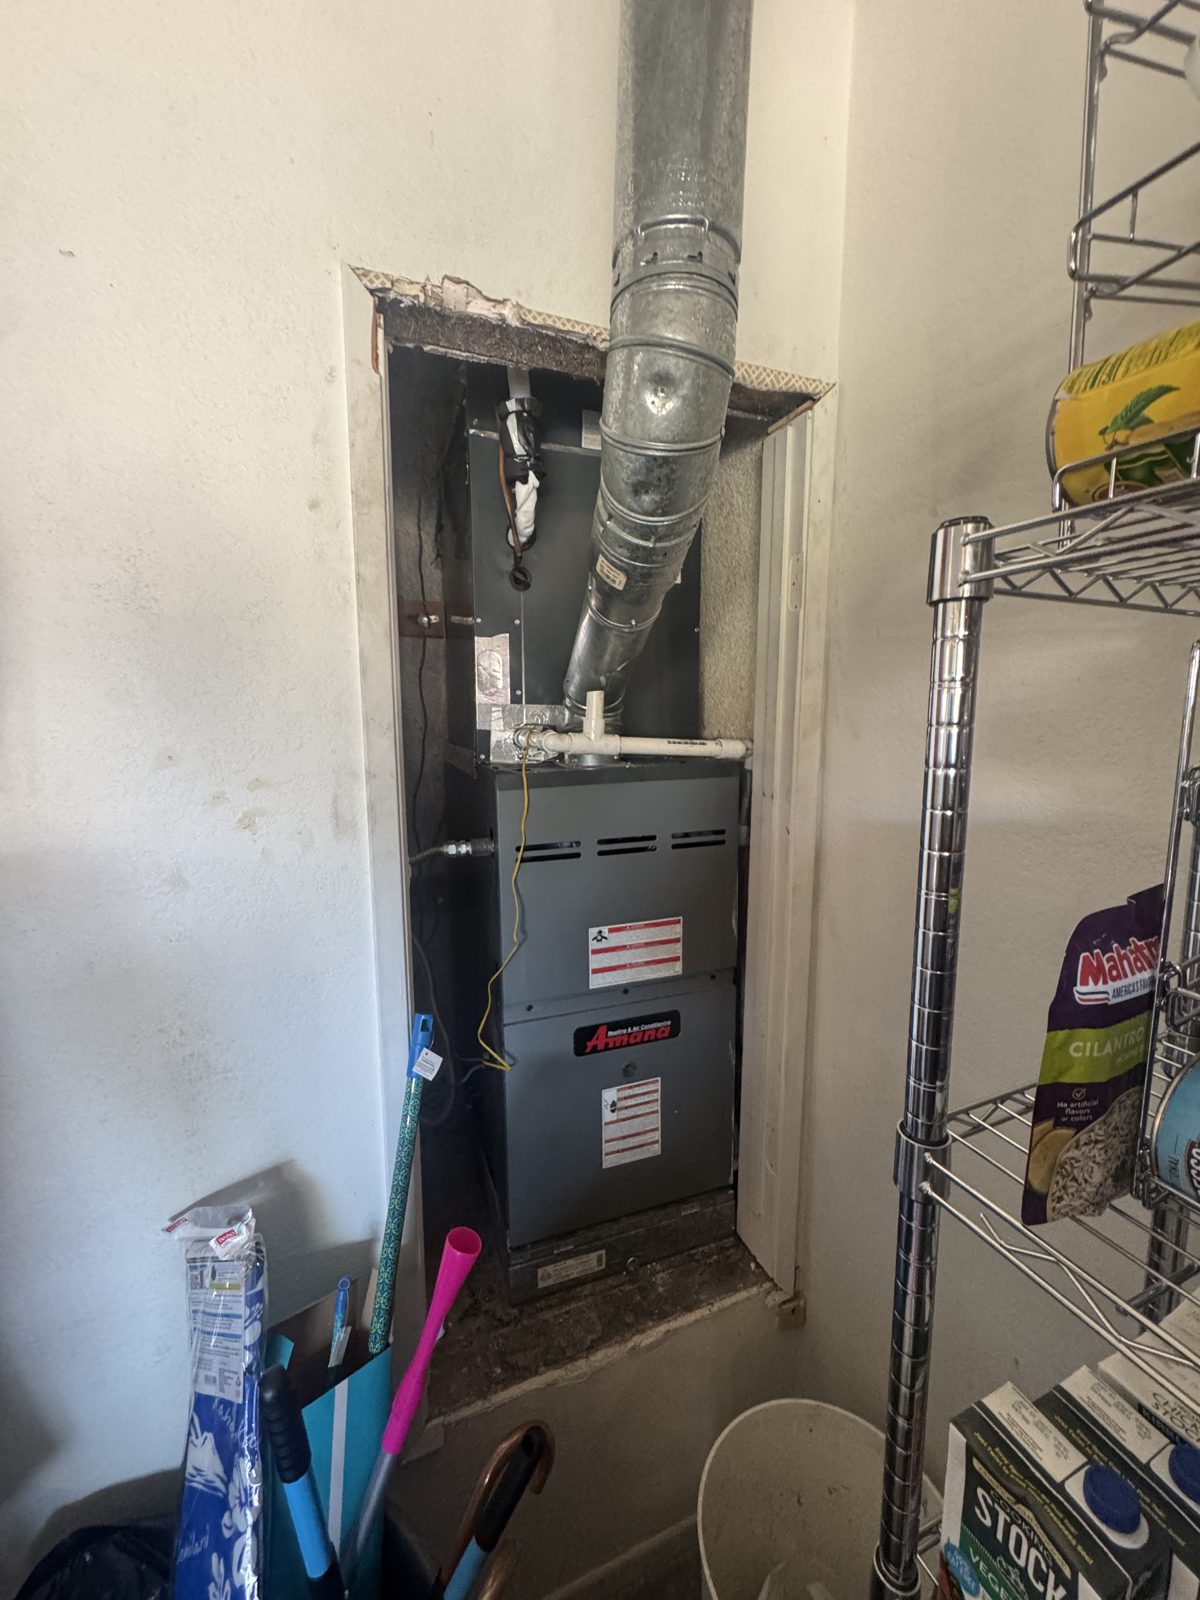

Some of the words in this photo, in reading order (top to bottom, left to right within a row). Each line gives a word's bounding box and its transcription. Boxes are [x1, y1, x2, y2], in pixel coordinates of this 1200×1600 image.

[585, 1024, 672, 1053] Amana
[1069, 1026, 1144, 1057] CILANTRO
[974, 1486, 1068, 1600] STOCK
